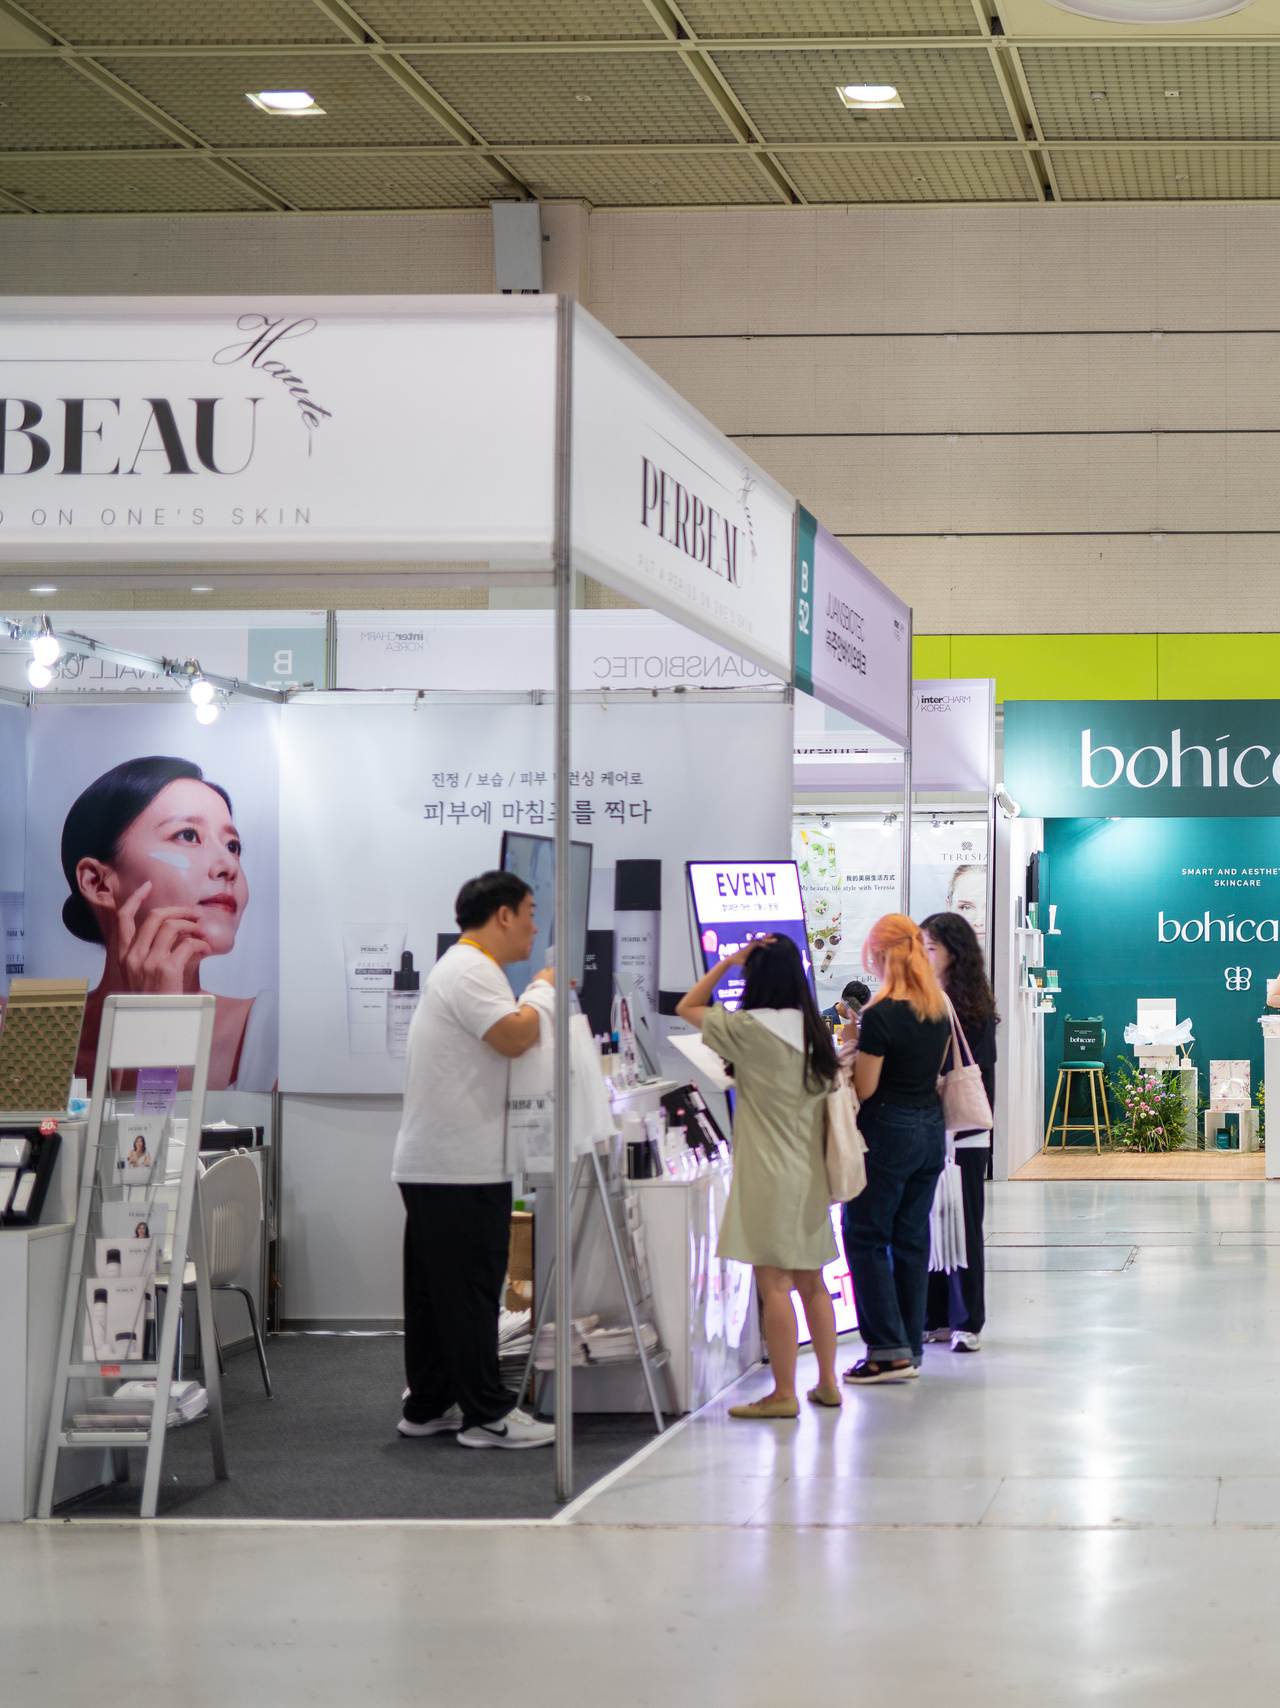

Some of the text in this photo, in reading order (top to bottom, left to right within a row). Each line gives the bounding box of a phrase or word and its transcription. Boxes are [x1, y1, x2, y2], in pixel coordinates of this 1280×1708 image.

[213, 313, 332, 430] Haute
[31, 507, 311, 525] ON ONE'S SKIN
[640, 454, 746, 589] PERBEAU
[801, 560, 809, 593] B
[798, 598, 810, 635] 52
[921, 694, 971, 704] interCHARM
[921, 705, 951, 713] KOREA
[431, 772, 459, 788] 진정
[476, 772, 504, 788] 보습
[520, 771, 548, 787] 피부
[600, 771, 644, 787] 케어로
[424, 800, 492, 825] 피부에
[604, 799, 652, 825] 찍다
[846, 874, 895, 882] 我的美丽生活方式
[1181, 868, 1213, 876] SMART
[1218, 868, 1237, 876] AND
[716, 872, 776, 896] EVENT
[1214, 879, 1262, 887] SKINCARE
